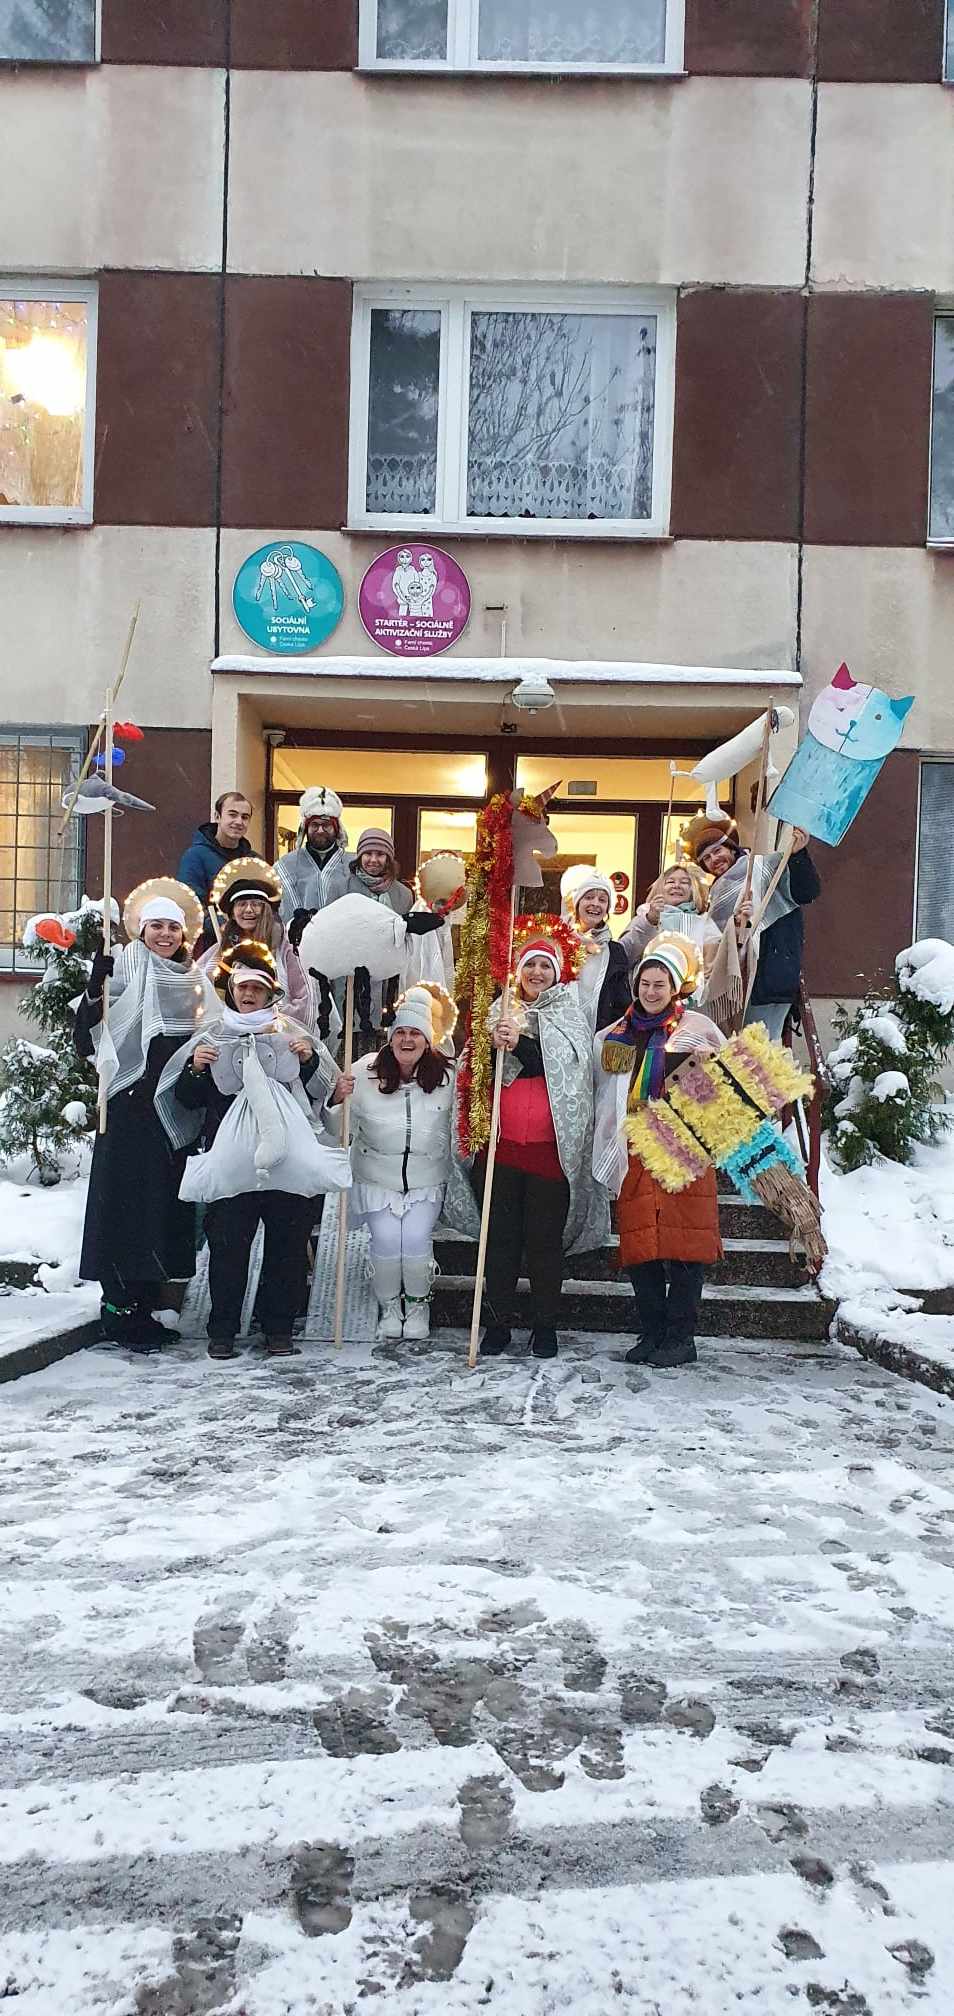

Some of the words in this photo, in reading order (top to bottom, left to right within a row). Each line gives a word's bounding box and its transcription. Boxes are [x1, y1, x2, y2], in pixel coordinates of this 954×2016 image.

[271, 615, 307, 625] SOCIÁLNÍ
[415, 619, 454, 629] SOCIÁLNĚ
[266, 626, 311, 634] UBYTOVNA
[375, 628, 423, 637] AKTIVIZAČNÍ
[423, 629, 453, 638] SLUŽBY
